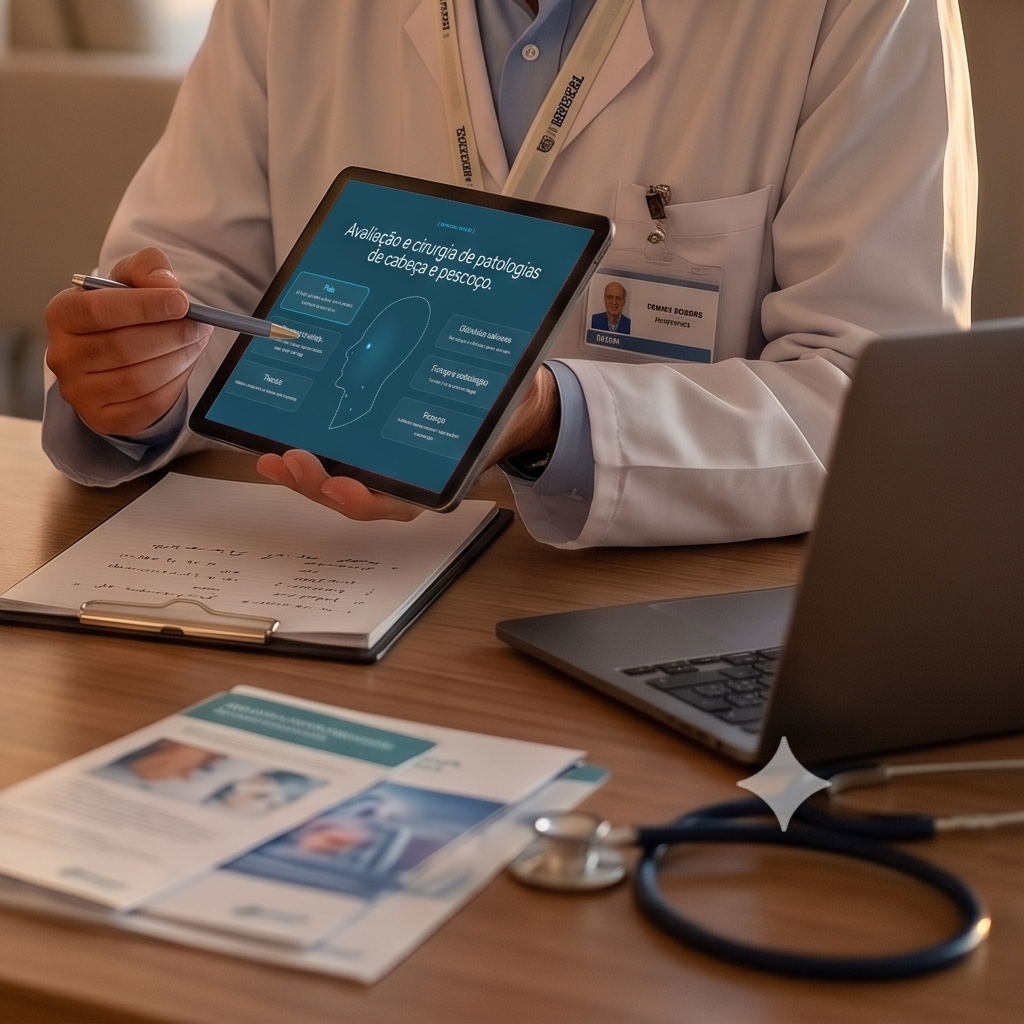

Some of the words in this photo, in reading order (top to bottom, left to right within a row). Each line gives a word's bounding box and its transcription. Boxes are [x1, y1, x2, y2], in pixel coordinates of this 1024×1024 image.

[367, 249, 384, 264] de
[384, 254, 428, 276] cabeça
[428, 265, 438, 277] e
[435, 267, 492, 292] pescoço.
[402, 238, 412, 250] e
[411, 238, 458, 262] cirurgia
[458, 248, 475, 264] de
[473, 255, 542, 280] patologias
